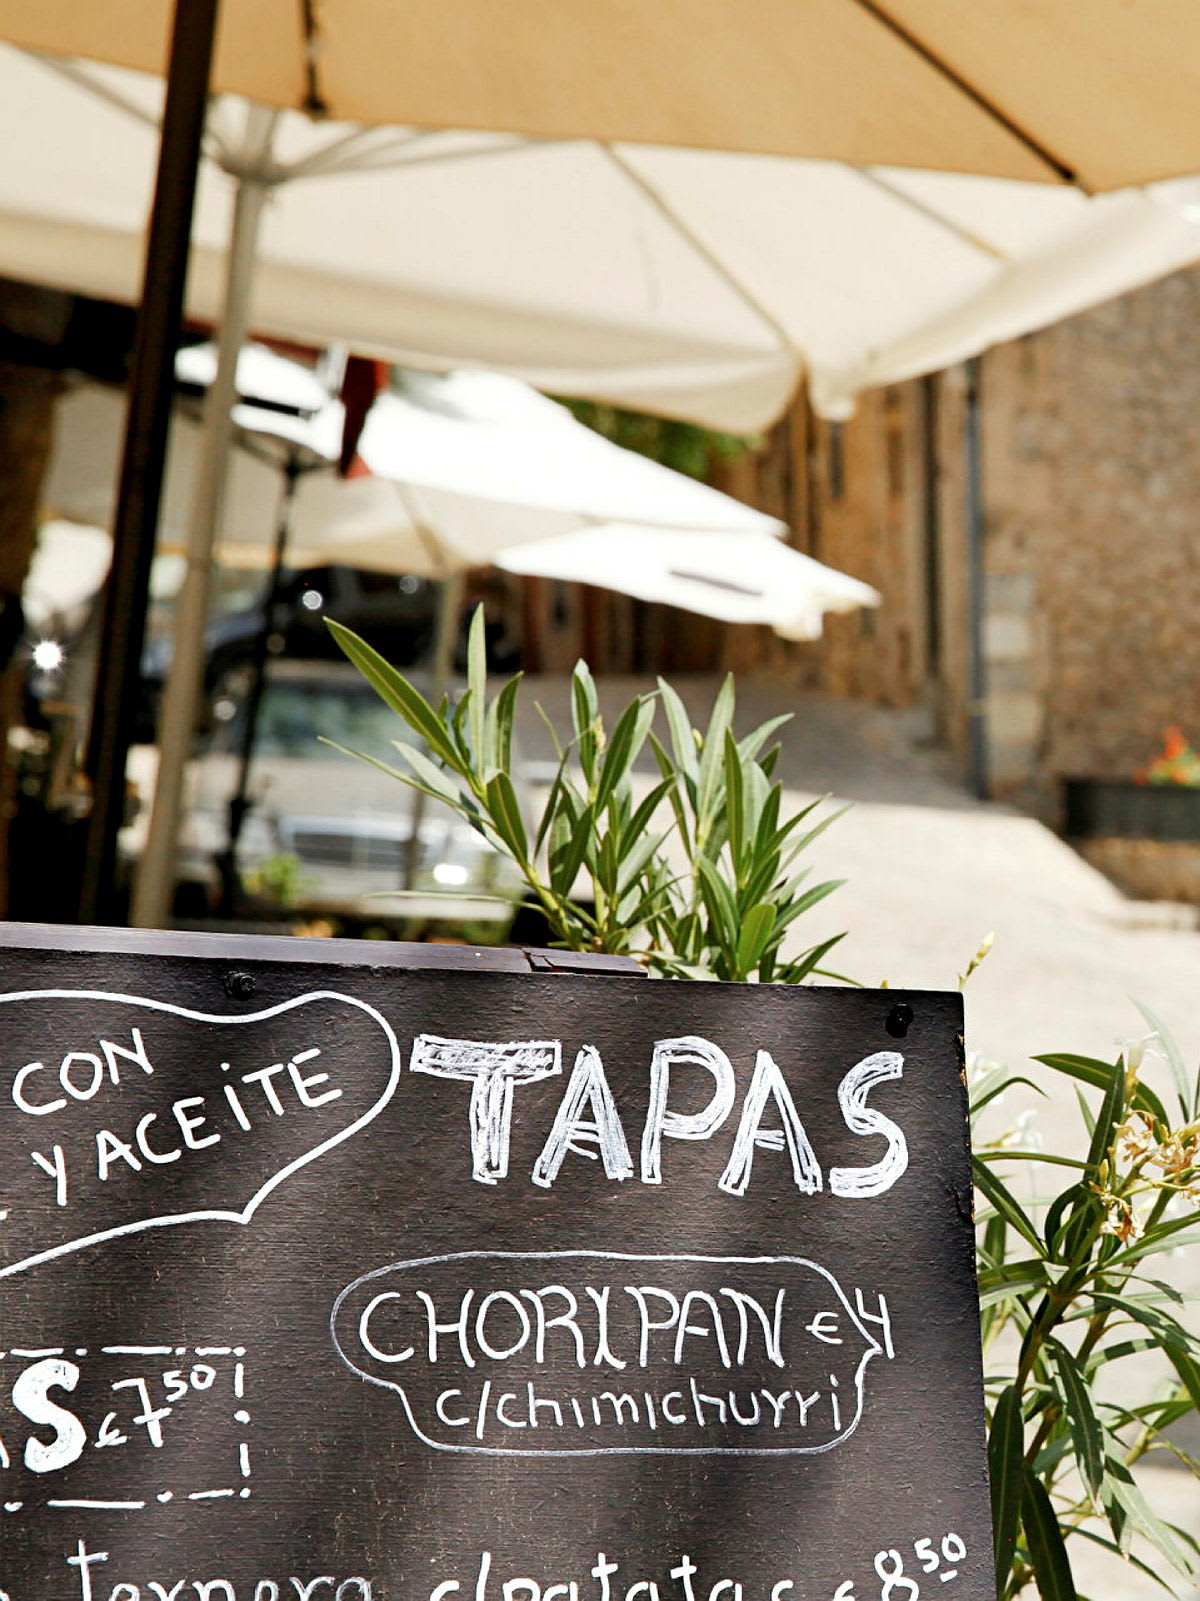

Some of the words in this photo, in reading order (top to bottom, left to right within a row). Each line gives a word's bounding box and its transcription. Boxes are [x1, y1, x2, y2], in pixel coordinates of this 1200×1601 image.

[11, 1027, 154, 1116] CON
[409, 1033, 909, 1198] TAPAS
[30, 1144, 68, 1207] Y
[358, 1284, 786, 1369] CHORIPAN
[0, 1357, 88, 1474] S
